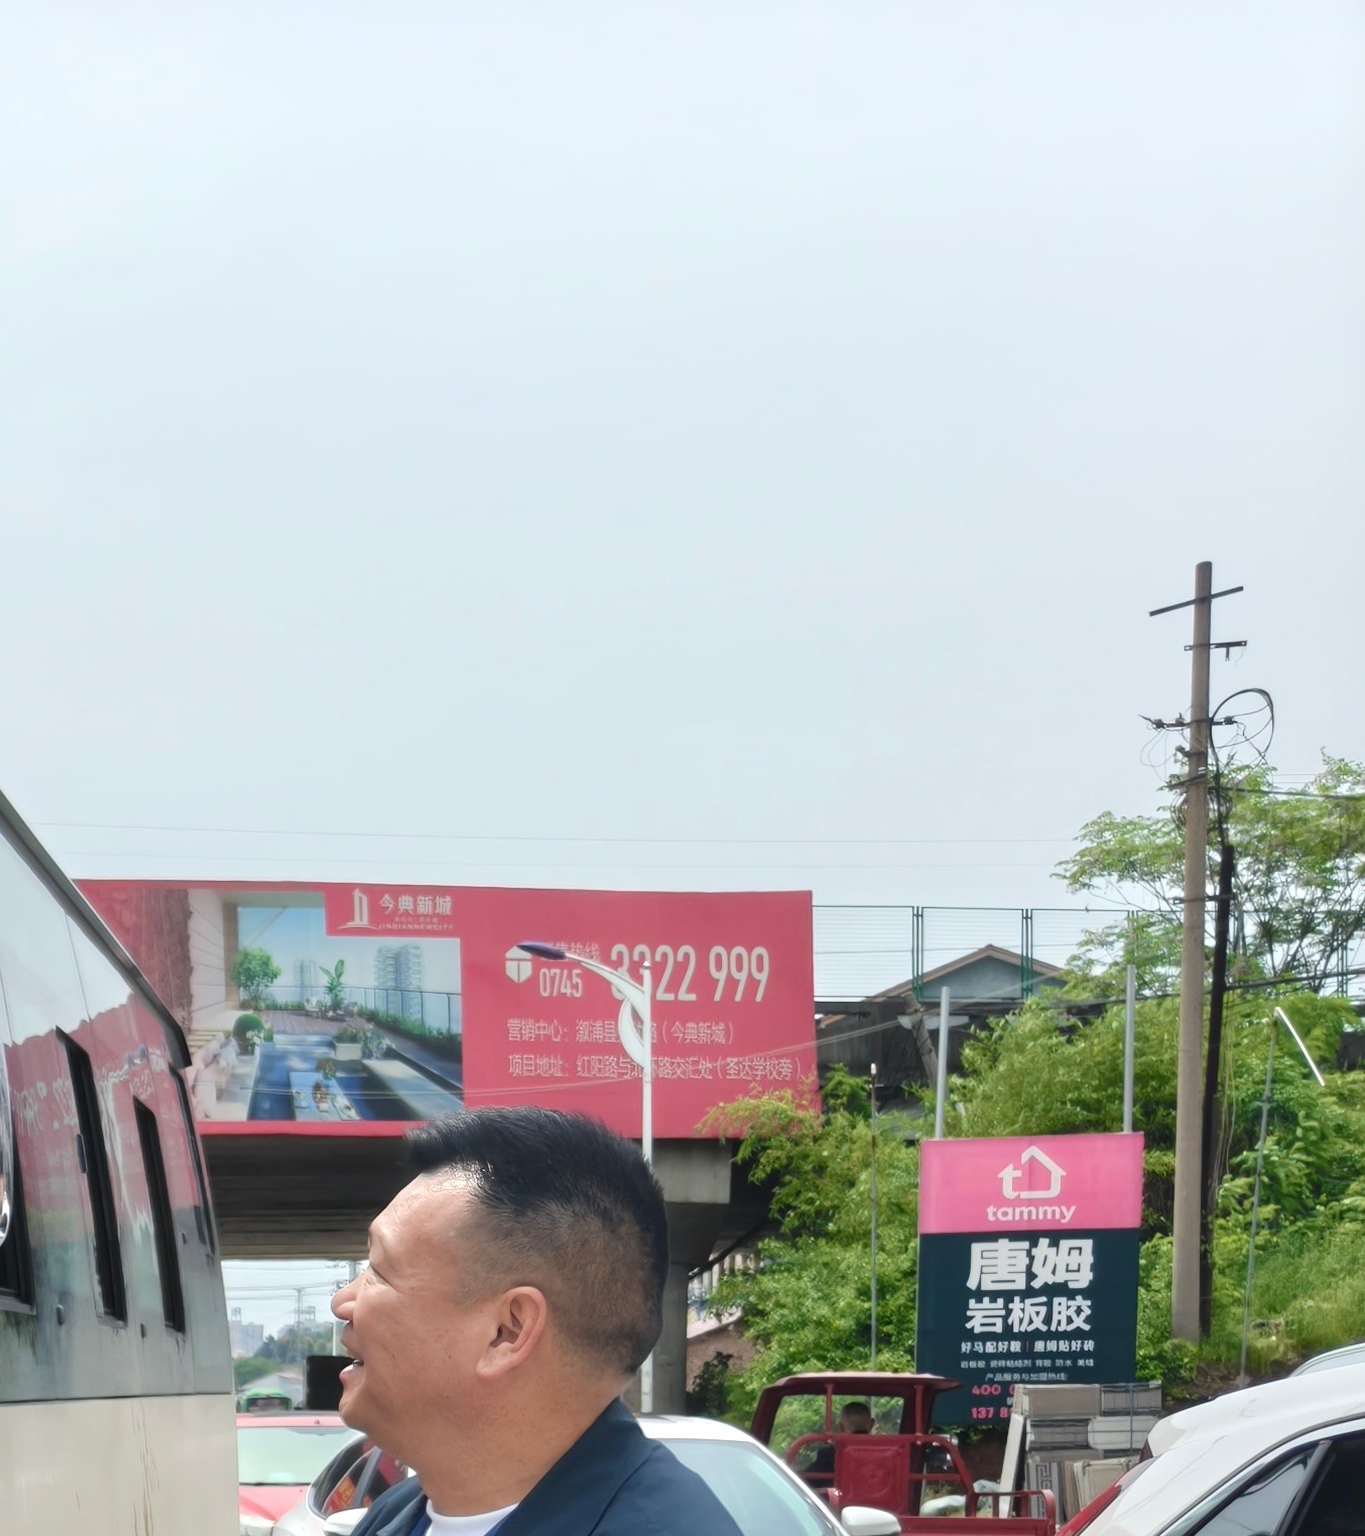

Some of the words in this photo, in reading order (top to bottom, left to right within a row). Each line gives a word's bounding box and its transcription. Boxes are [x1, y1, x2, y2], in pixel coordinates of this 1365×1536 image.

[379, 893, 453, 916] 今典新城
[539, 968, 584, 998] 0745
[709, 945, 769, 1003] 999
[986, 1204, 1077, 1224] tammy
[966, 1237, 1094, 1291] 唐姆
[965, 1295, 1092, 1334] 岩板胶
[971, 1384, 1002, 1396] 400
[971, 1407, 994, 1419] 137
